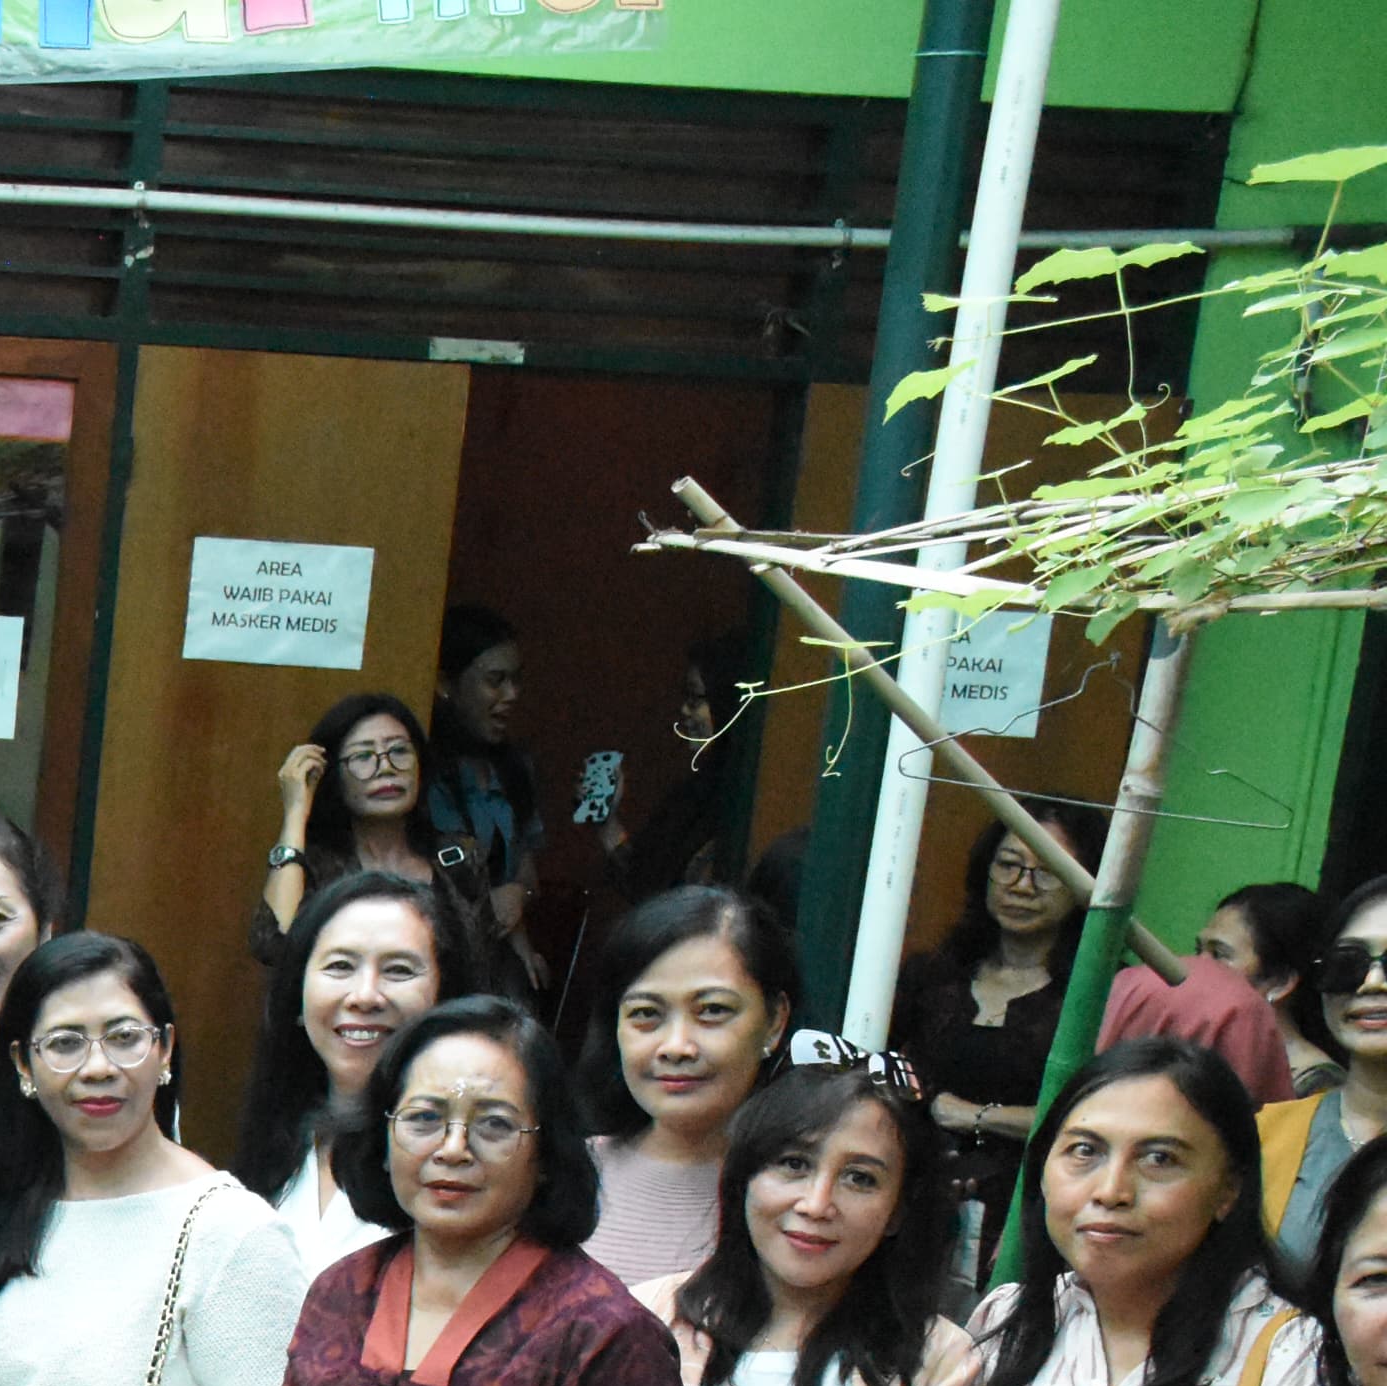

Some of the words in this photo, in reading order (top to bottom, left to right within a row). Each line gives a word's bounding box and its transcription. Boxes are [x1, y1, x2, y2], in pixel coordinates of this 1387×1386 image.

[256, 560, 303, 577] AREA
[223, 585, 274, 603] WAJIB
[278, 588, 333, 606] PAKAI
[211, 611, 281, 630] MASKER
[286, 617, 338, 634] MEDIS
[951, 684, 1009, 701] MEDIS
